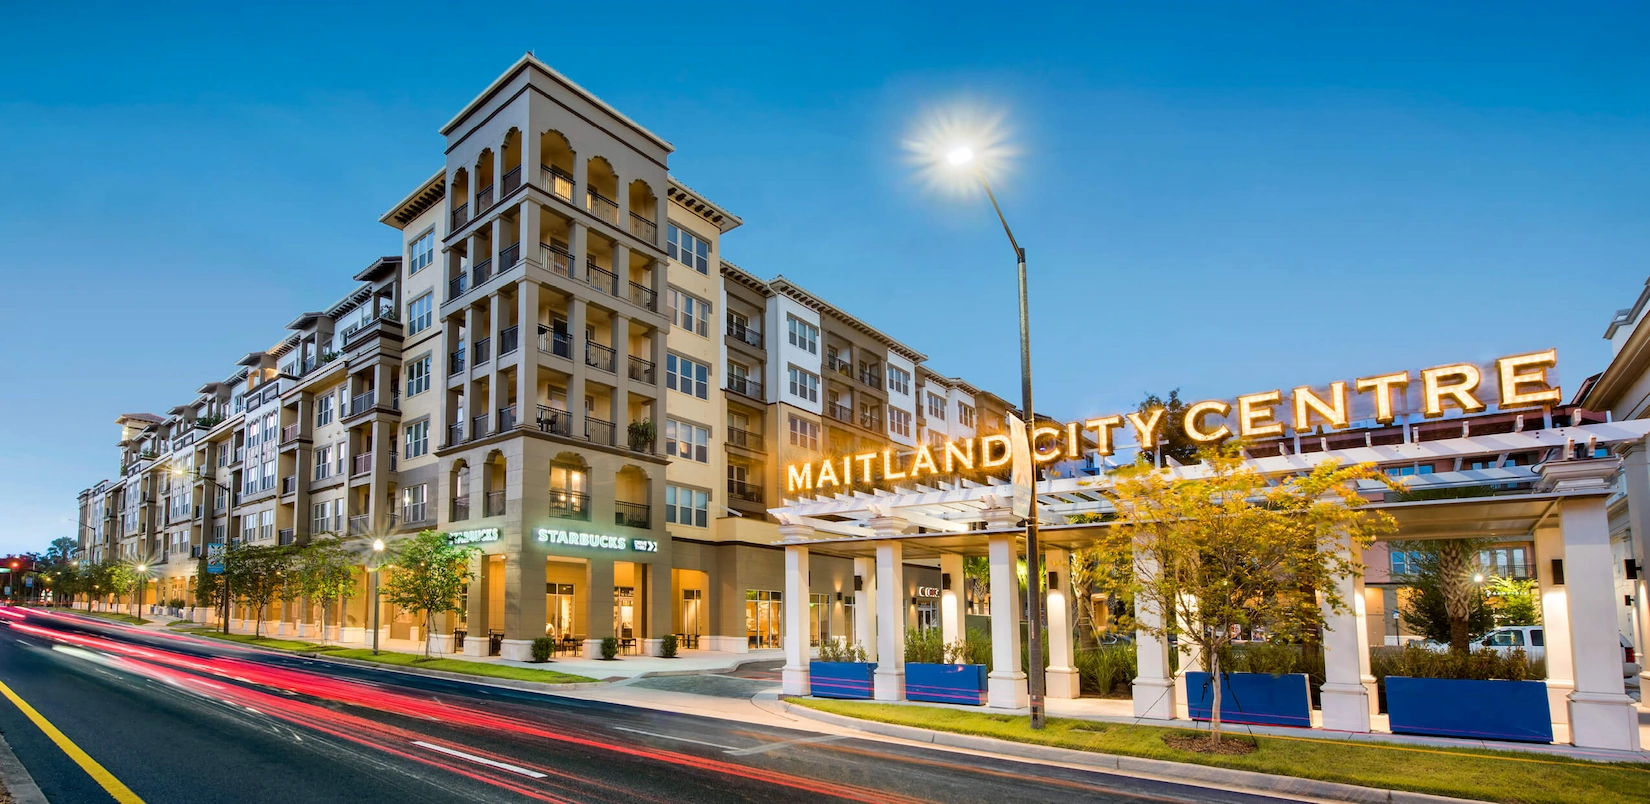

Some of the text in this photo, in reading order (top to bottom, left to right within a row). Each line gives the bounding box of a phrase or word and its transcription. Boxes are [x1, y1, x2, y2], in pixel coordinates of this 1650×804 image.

[786, 348, 1562, 492] MAITLAND CITY CENTRE
[538, 528, 626, 550] STARBUCKS
